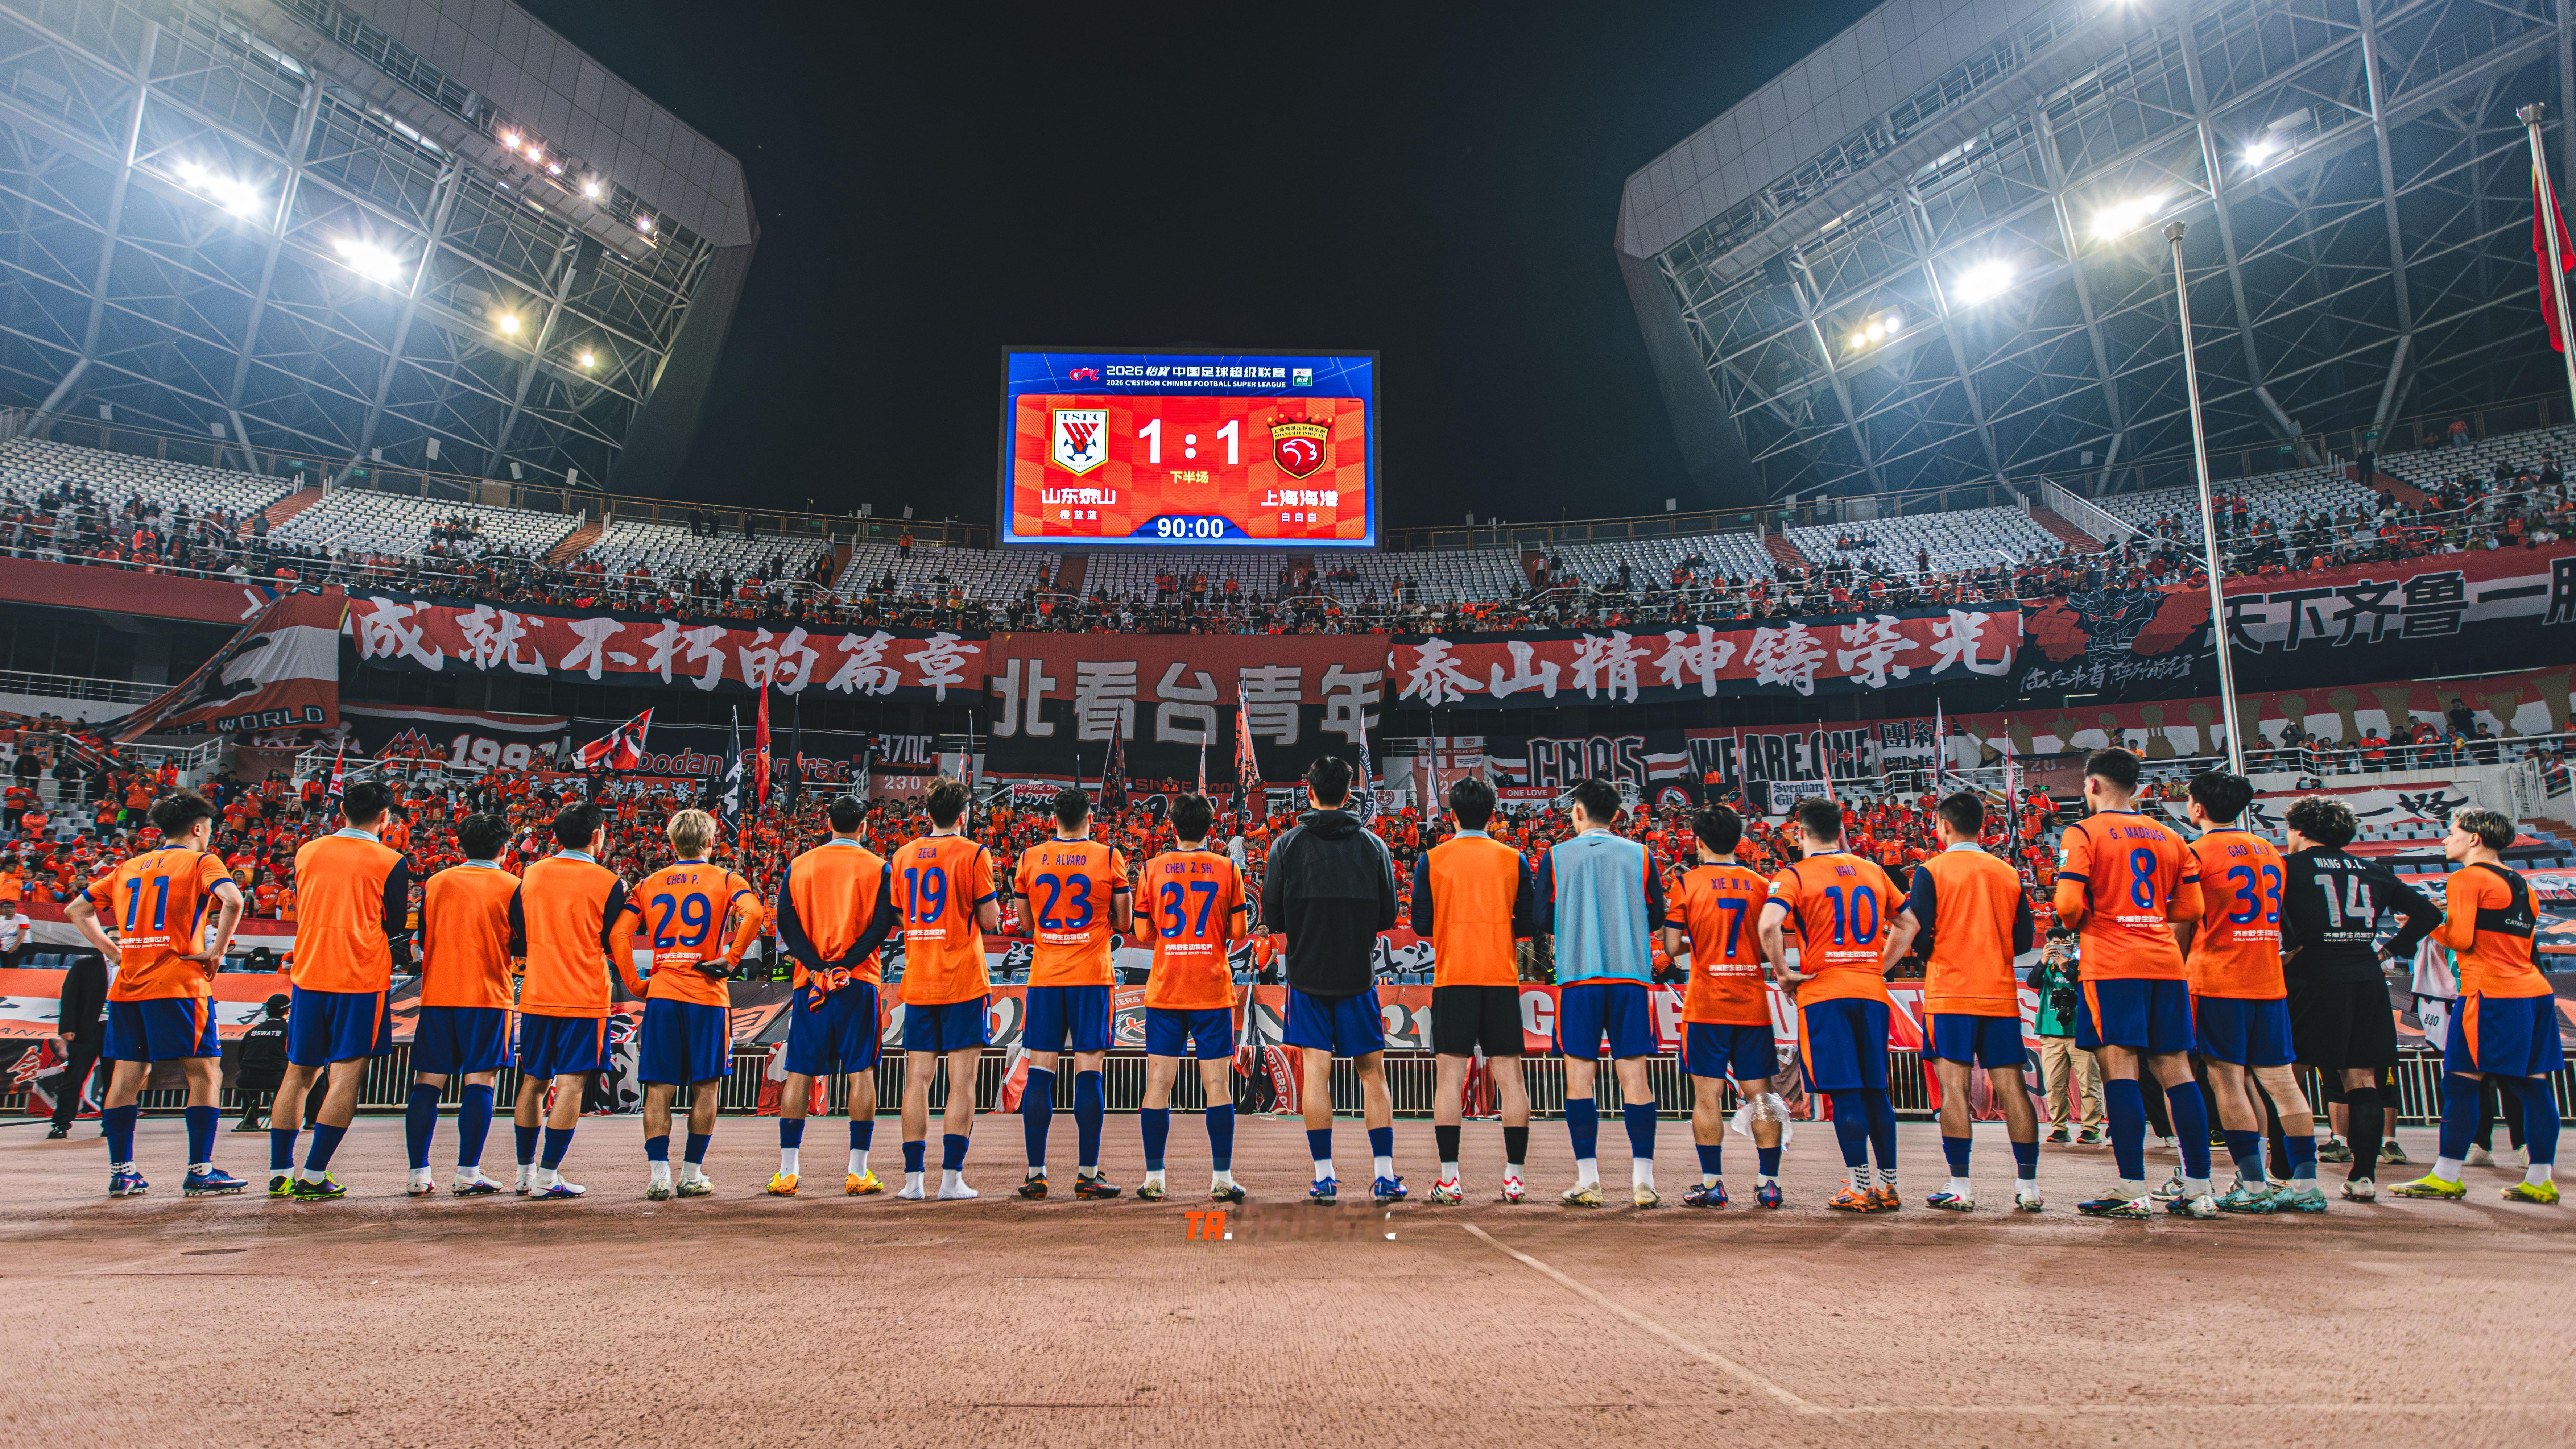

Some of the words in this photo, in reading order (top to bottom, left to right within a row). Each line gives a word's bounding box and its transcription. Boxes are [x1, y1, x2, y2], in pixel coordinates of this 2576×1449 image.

[1107, 365, 1143, 376] 2026
[1173, 366, 1286, 378] 中国足球超级联赛
[1139, 419, 1161, 464] 1
[1216, 419, 1239, 465] 1
[1170, 471, 1209, 483] 下半场
[1041, 488, 1116, 504] 山东泰山
[1261, 490, 1339, 507] 上海海港
[1281, 511, 1317, 522] 白白白
[1157, 518, 1224, 538] 90:00
[359, 596, 980, 702] 成就不朽的篇章
[992, 658, 1383, 746] 北看台青年
[219, 708, 323, 732] WORLD
[635, 747, 723, 776] bodan
[918, 847, 936, 859] ZECA
[1042, 854, 1049, 865] P.
[1056, 854, 1086, 866] ALVARO
[2227, 844, 2248, 857] GAO
[140, 858, 153, 870] LIU
[1166, 862, 1185, 874] CHEN
[2313, 857, 2341, 869] WANG
[667, 874, 687, 885] CHEN
[692, 874, 699, 885] P.
[1711, 878, 1726, 889] XIE
[2130, 847, 2156, 909] 8
[904, 866, 947, 924] 19
[1244, 883, 1260, 897] AISHAN
[2227, 864, 2282, 924] 33
[2314, 874, 2375, 928] 14
[125, 876, 170, 932] 11
[1035, 873, 1093, 930] 23
[1160, 881, 1219, 938] 37
[651, 893, 711, 949] 29
[1824, 885, 1878, 945] 10
[1717, 898, 1748, 957] 7
